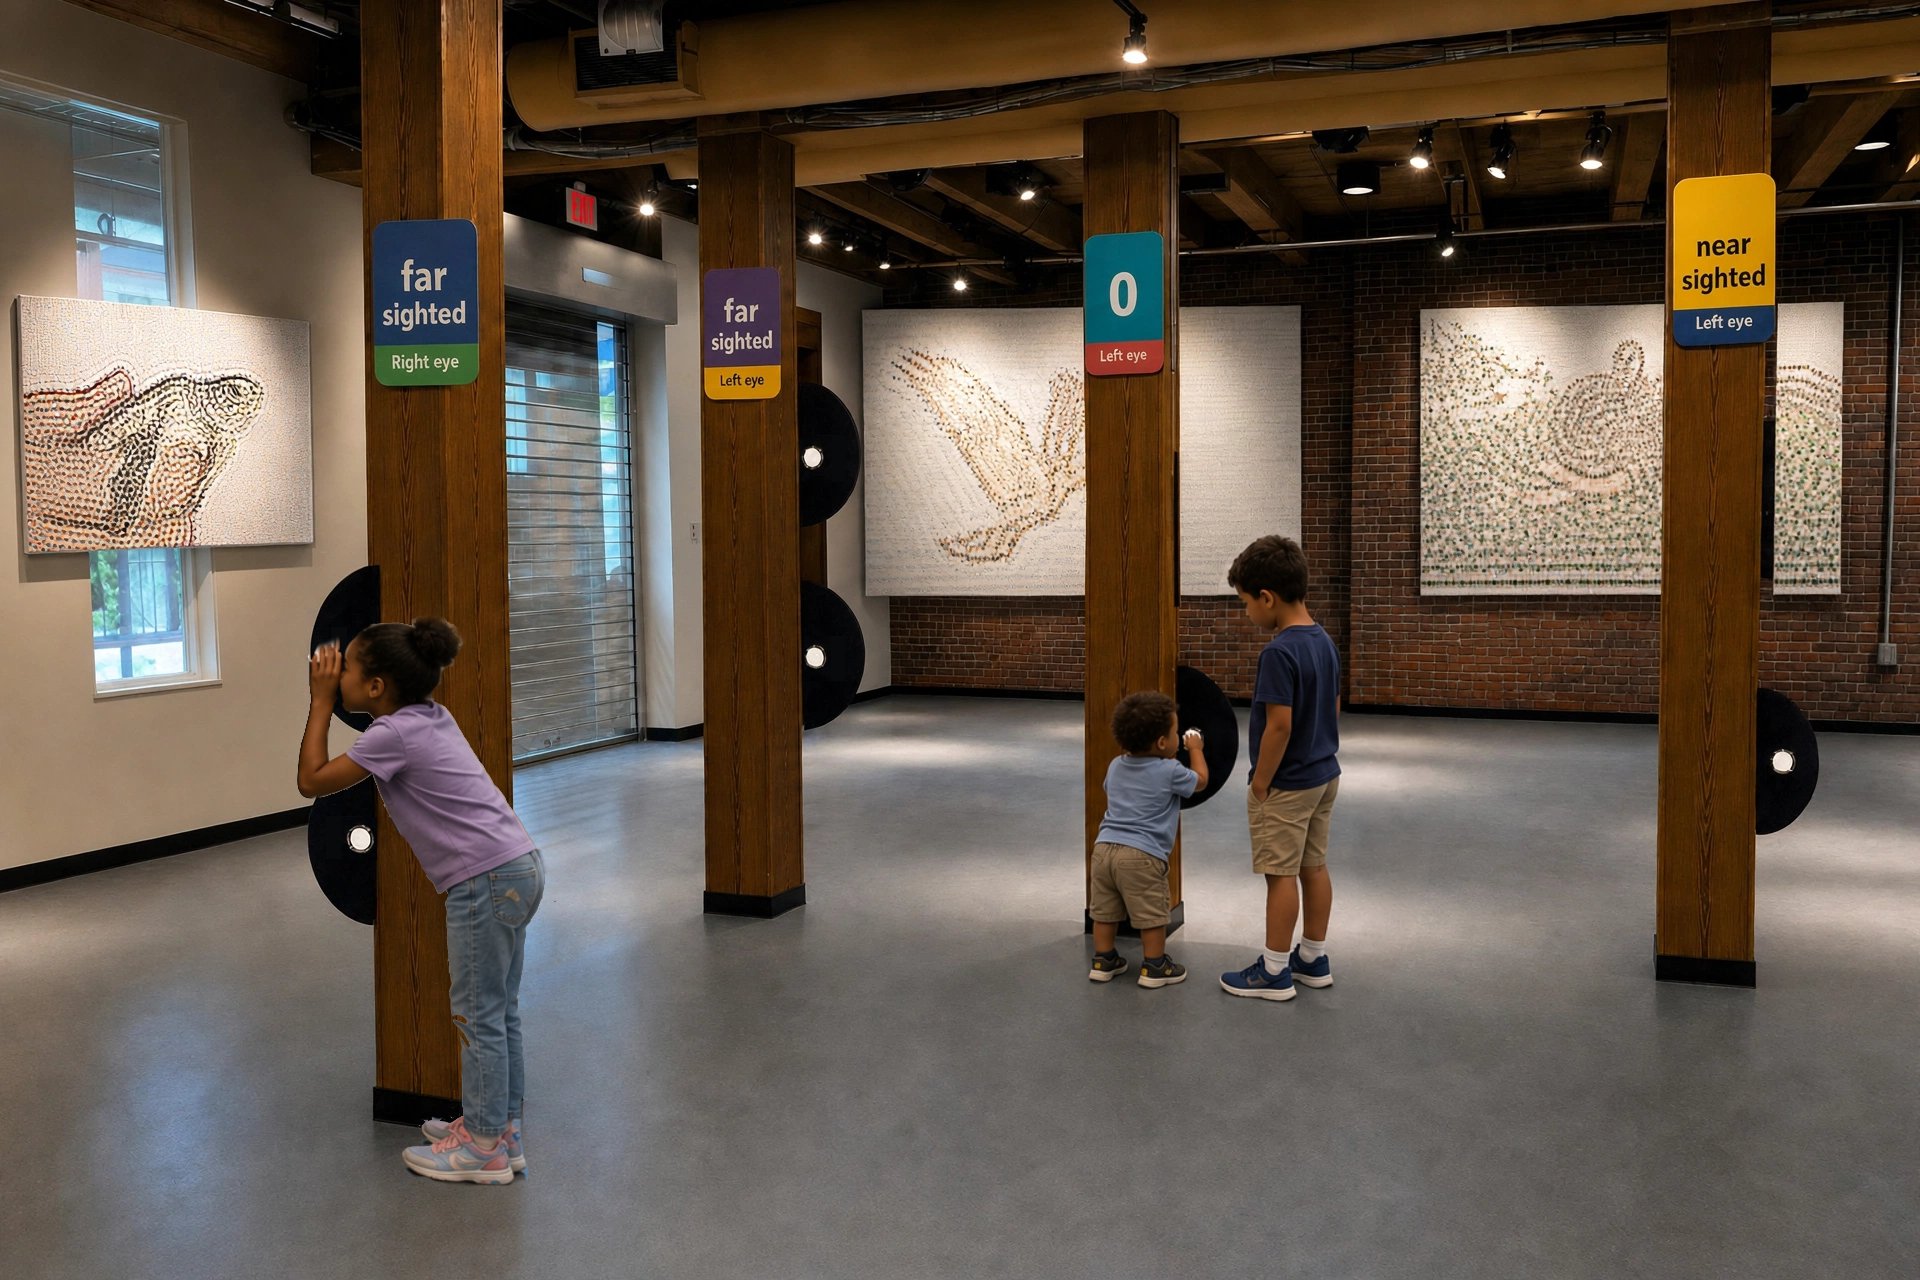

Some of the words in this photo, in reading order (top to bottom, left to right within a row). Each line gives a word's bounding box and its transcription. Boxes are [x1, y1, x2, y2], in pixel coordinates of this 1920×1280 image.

[1697, 237, 1751, 257] near
[401, 258, 448, 292] far
[1682, 263, 1766, 295] sighted
[1109, 271, 1138, 317] 0
[382, 300, 466, 332] sighted
[723, 297, 759, 323] far
[1695, 314, 1724, 330] Left
[1727, 316, 1753, 331] eye
[711, 330, 773, 355] sighted
[391, 353, 430, 373] Right
[433, 357, 460, 372] eye
[1100, 348, 1124, 362] Left
[1126, 351, 1147, 364] eye
[720, 373, 742, 387] Left
[744, 376, 765, 389] eye
